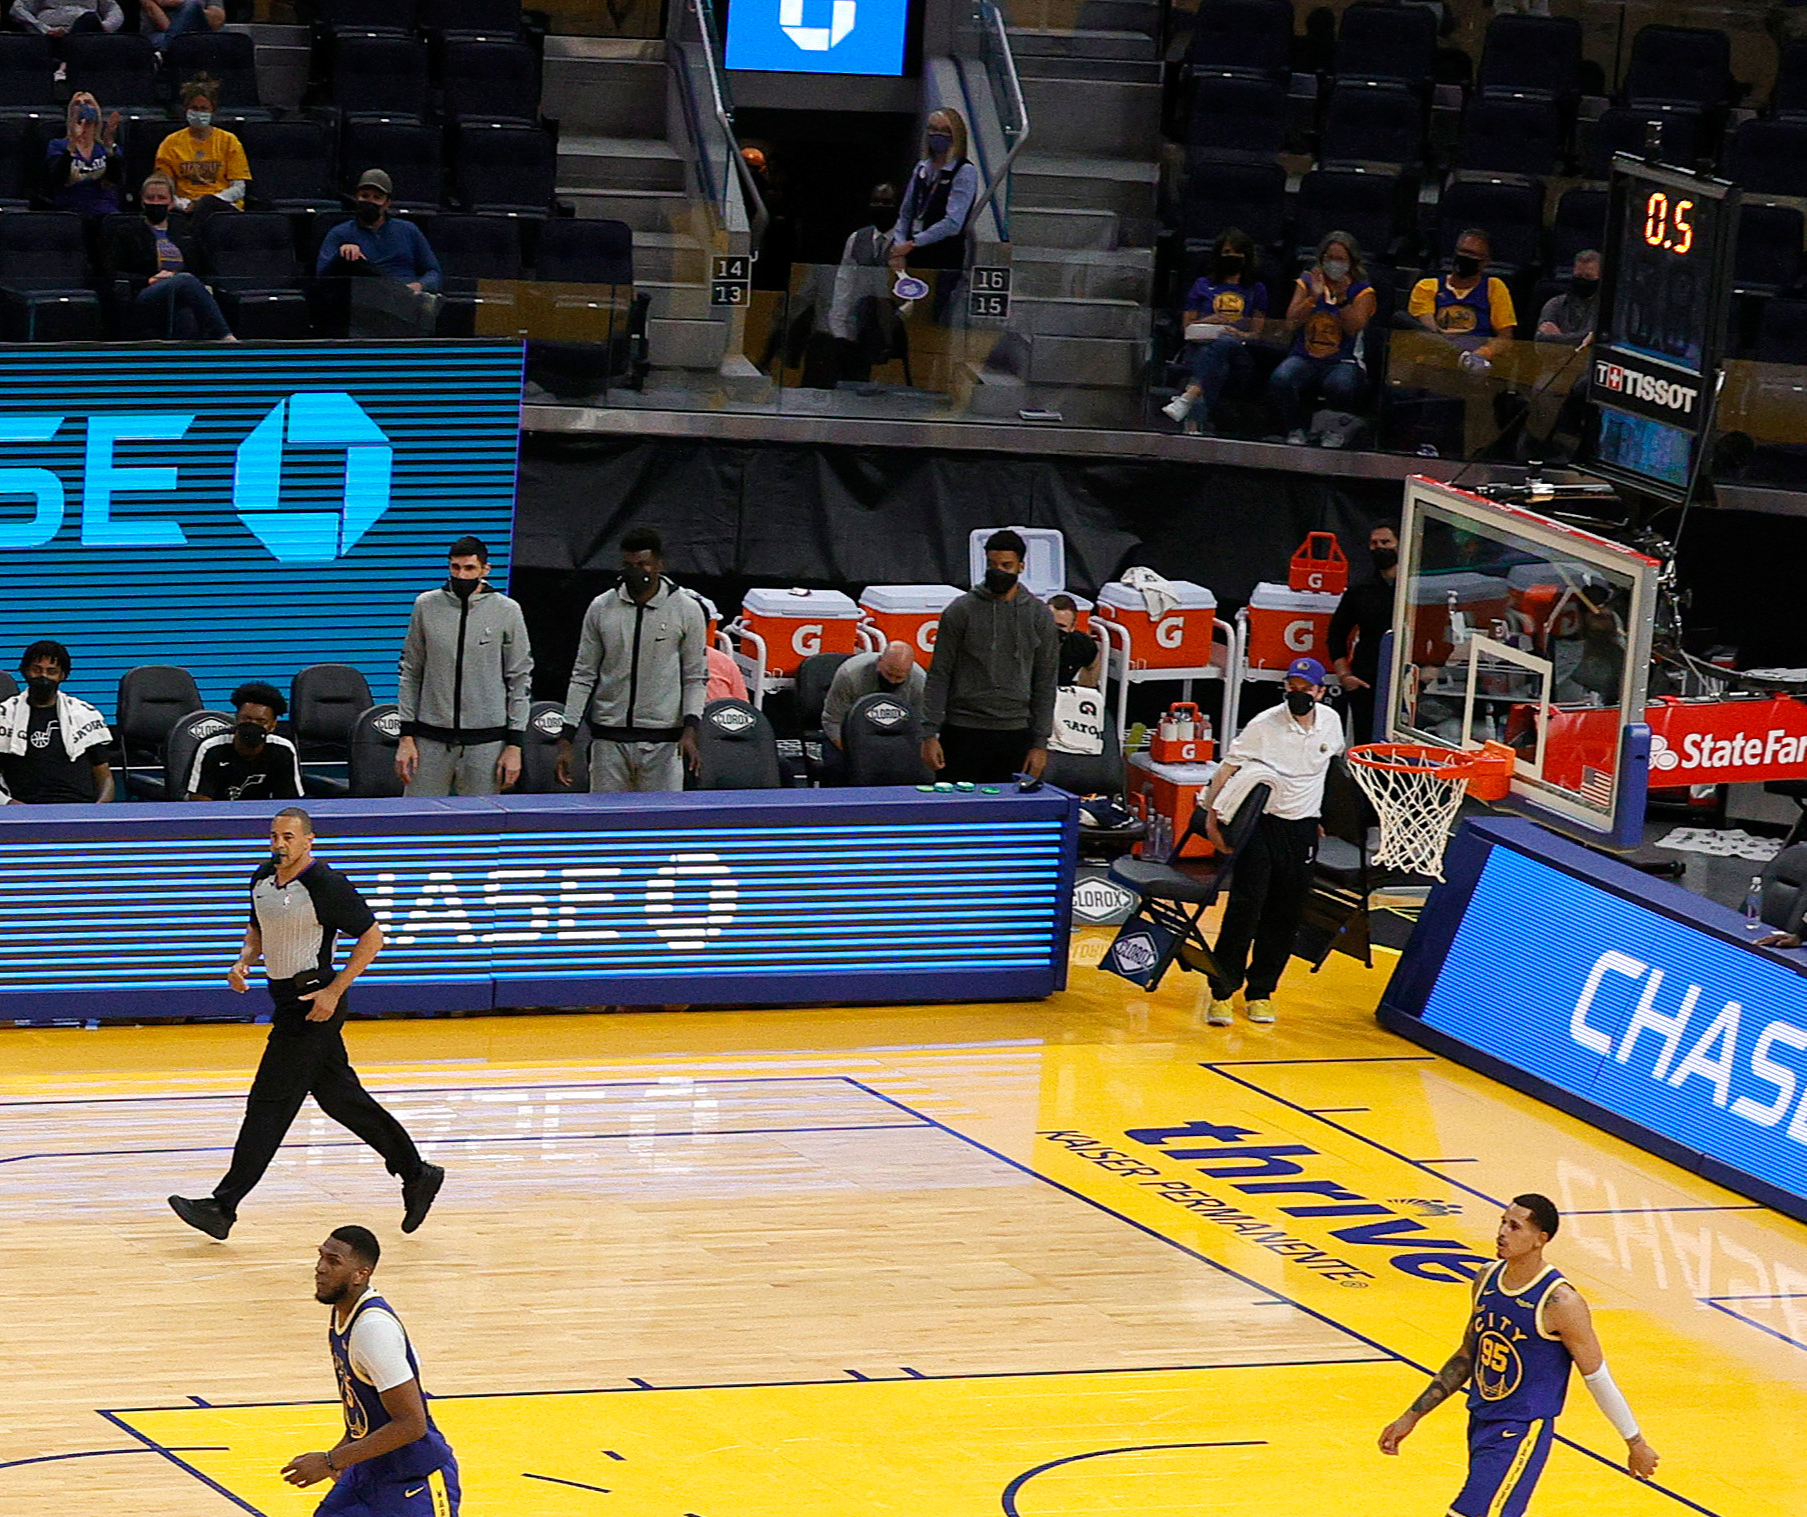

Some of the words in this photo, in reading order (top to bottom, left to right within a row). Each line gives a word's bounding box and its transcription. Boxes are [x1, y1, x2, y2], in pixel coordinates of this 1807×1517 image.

[1644, 192, 1693, 254] 0.5
[719, 260, 742, 277] 14
[978, 271, 1003, 288] 16
[716, 286, 741, 302] 13
[977, 297, 1002, 314] 15
[1624, 374, 1698, 414] TISSOT
[1308, 573, 1323, 590] G
[792, 624, 823, 657] G
[1156, 616, 1185, 649] G
[1284, 619, 1314, 652] G
[1182, 743, 1196, 760] G
[1035, 1128, 1161, 1178] KAISER
[1124, 1118, 1491, 1285] thrive
[1475, 1307, 1529, 1342] CITY
[1480, 1336, 1510, 1373] 95
